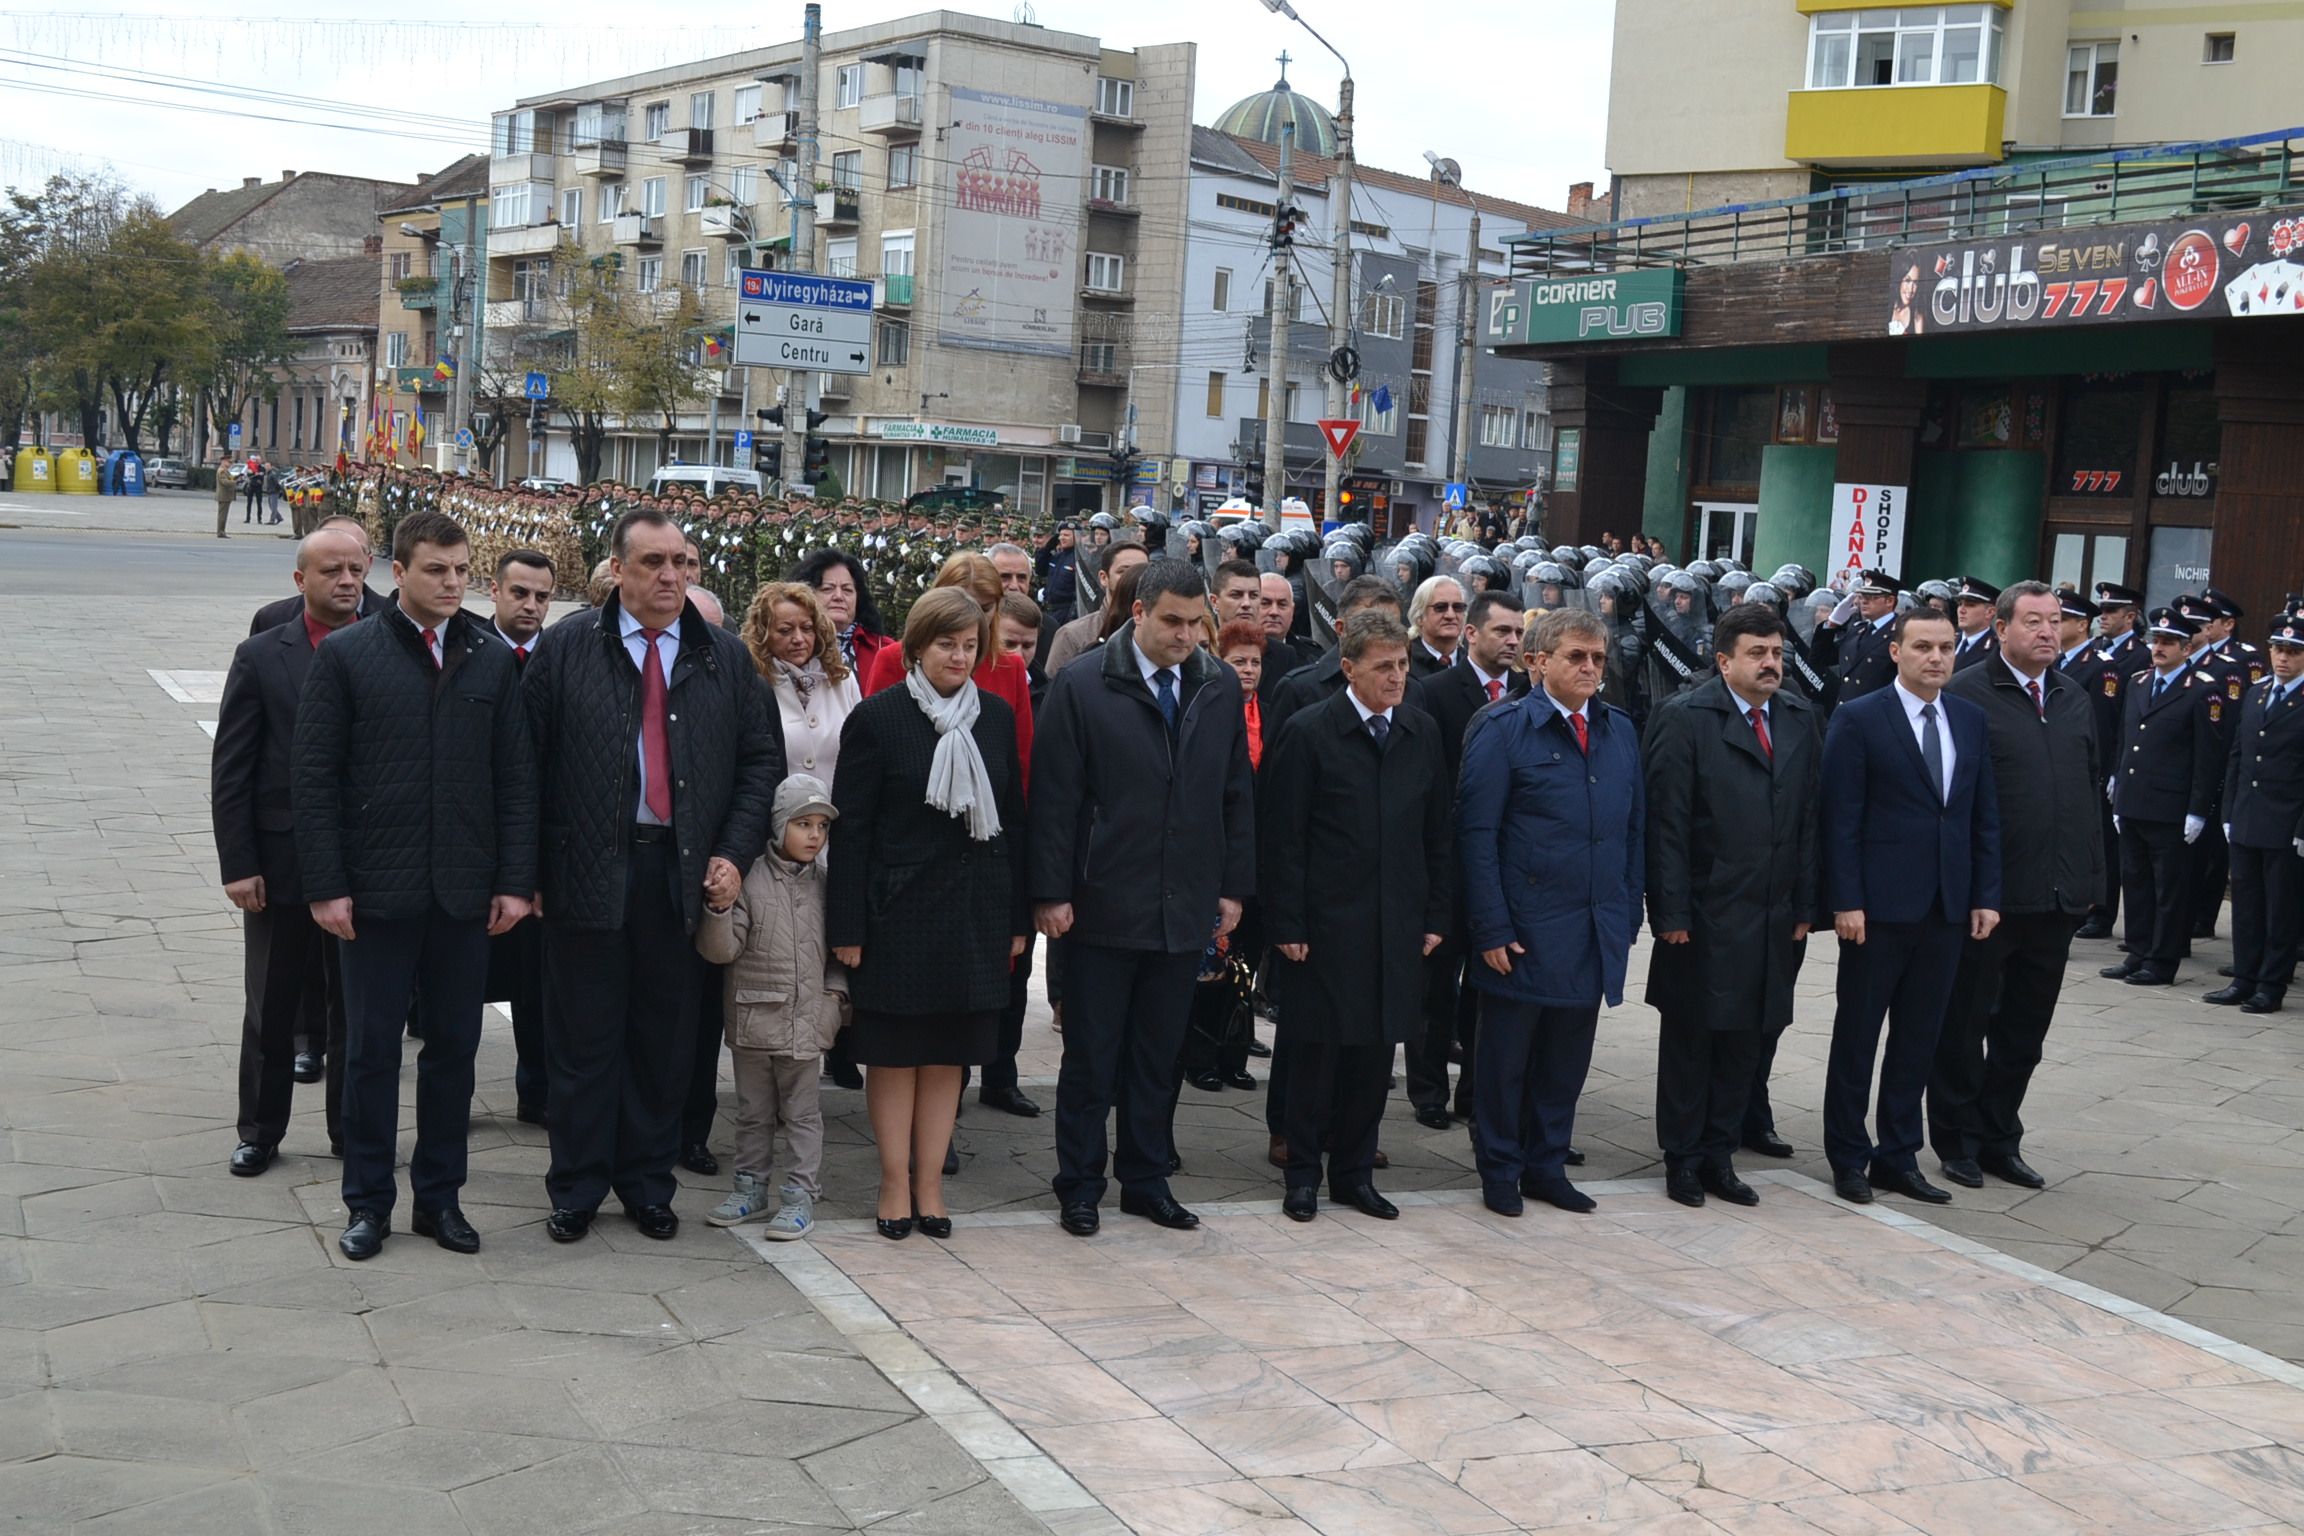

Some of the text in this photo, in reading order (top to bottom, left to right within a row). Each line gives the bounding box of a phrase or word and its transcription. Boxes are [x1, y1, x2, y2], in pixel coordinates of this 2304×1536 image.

[980, 93, 1058, 113] www.lissim.ro
[965, 121, 980, 132] din
[983, 124, 993, 134] 10
[1025, 129, 1044, 144] aleg
[1046, 132, 1077, 146] LISSIM
[2038, 241, 2124, 274] SEVEN
[763, 277, 853, 304] Nyiregyháza
[1932, 245, 2040, 326] club
[2175, 268, 2209, 289] ALL-IN
[1536, 279, 1617, 305] CORNER
[2041, 277, 2128, 319] 777
[790, 313, 823, 334] Gară
[1578, 302, 1666, 338] PUB
[781, 341, 830, 364] Centru
[738, 431, 748, 448] P
[883, 423, 917, 433] FARMACIA
[943, 426, 997, 439] FARMACIA
[1072, 465, 1112, 477] Amane
[2072, 470, 2122, 492] 777
[2156, 461, 2208, 496] club
[1846, 487, 1868, 569] DIANA
